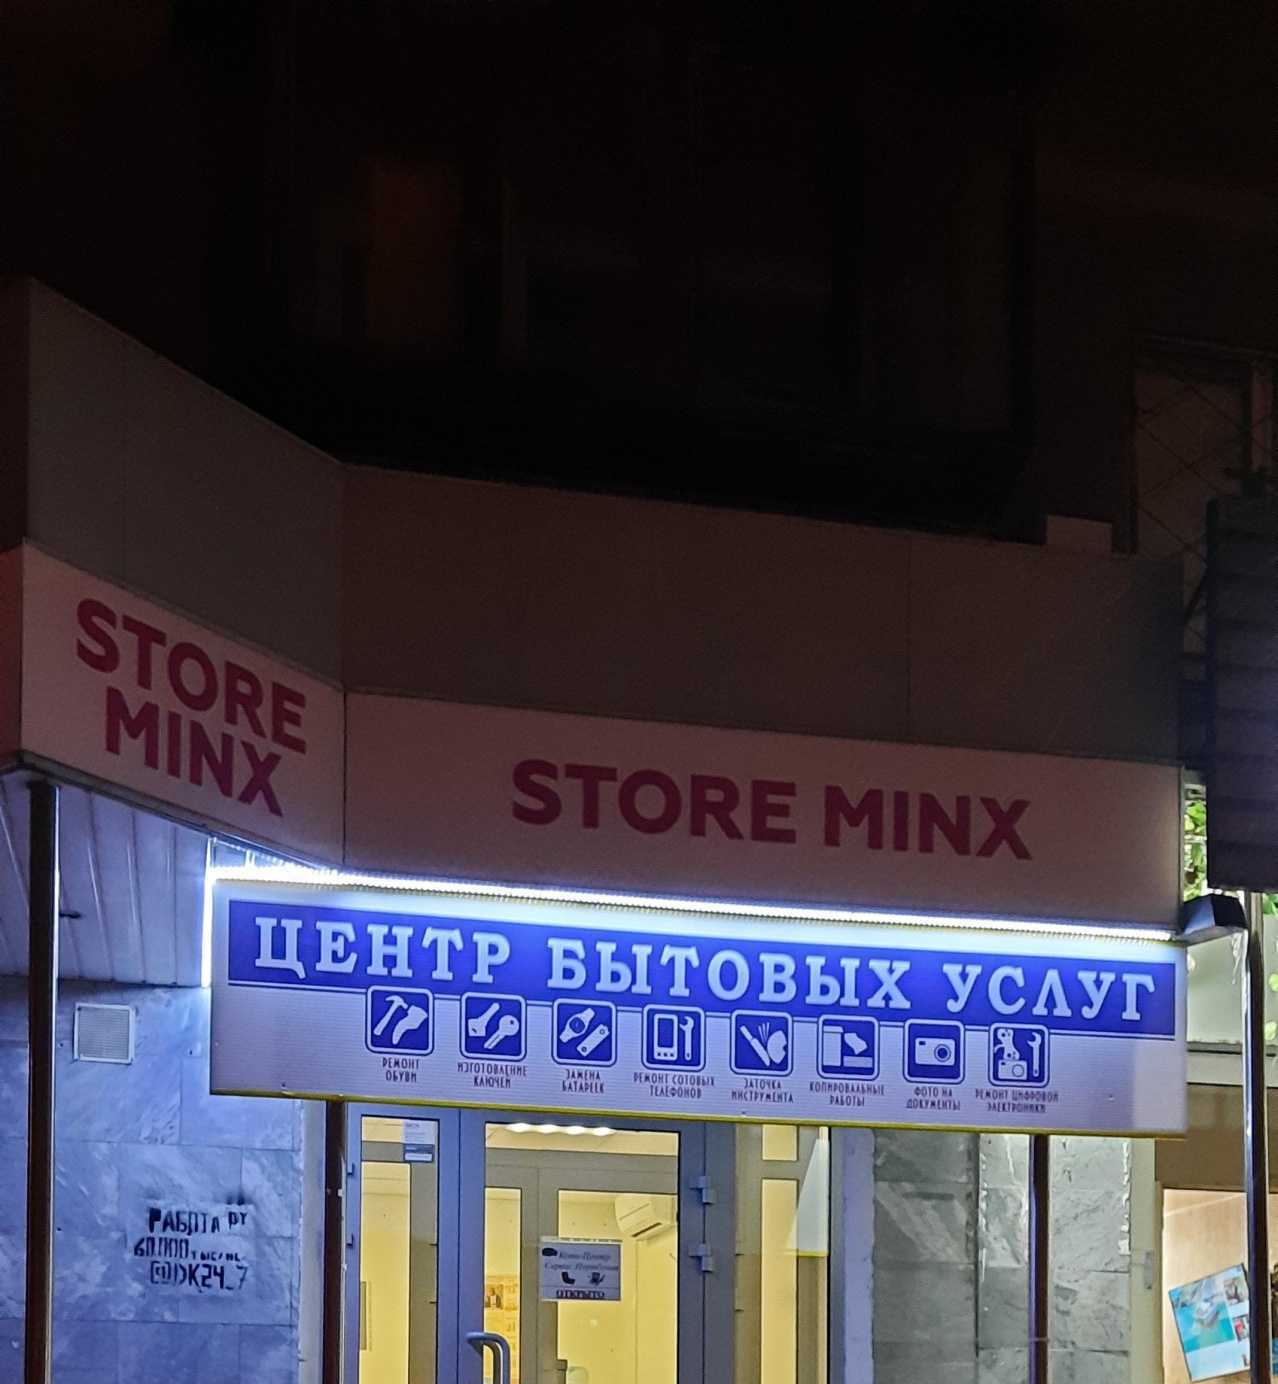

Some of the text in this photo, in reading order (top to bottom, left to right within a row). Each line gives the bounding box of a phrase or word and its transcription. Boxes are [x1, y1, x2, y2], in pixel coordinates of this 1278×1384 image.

[76, 598, 306, 754] STORE
[105, 686, 283, 817] MINX
[511, 759, 1033, 860] STORE MINX
[254, 917, 1155, 1021] ЦЕНТР БЫТОВЫХ УСЛУГ
[382, 1057, 420, 1069] РЕМОНТ
[457, 1062, 528, 1077] ИЗГОТОВЛЕНИЕ
[385, 1070, 417, 1083] ОБУВИ
[565, 1069, 601, 1081] ЗАМЕНА
[633, 1072, 715, 1087] РЕМОНТ СОТОВЫХ
[562, 1080, 604, 1094] БАТАРЕЕК
[744, 1078, 782, 1090] ЗАТОЧКА
[809, 1081, 885, 1095] КОПИРОВАЛЬНЫЕ
[649, 1085, 703, 1099] ТЕЛЕФОНОВ
[731, 1090, 794, 1103] ИНСТРУМЕНТА
[914, 1087, 953, 1098] ФОТО НА
[975, 1088, 1008, 1100] РЕМОНТ
[830, 1095, 865, 1107] РАБОТЫ
[906, 1098, 961, 1111] ДОКУМЕНТЫ
[149, 1207, 220, 1236] РАБОТА
